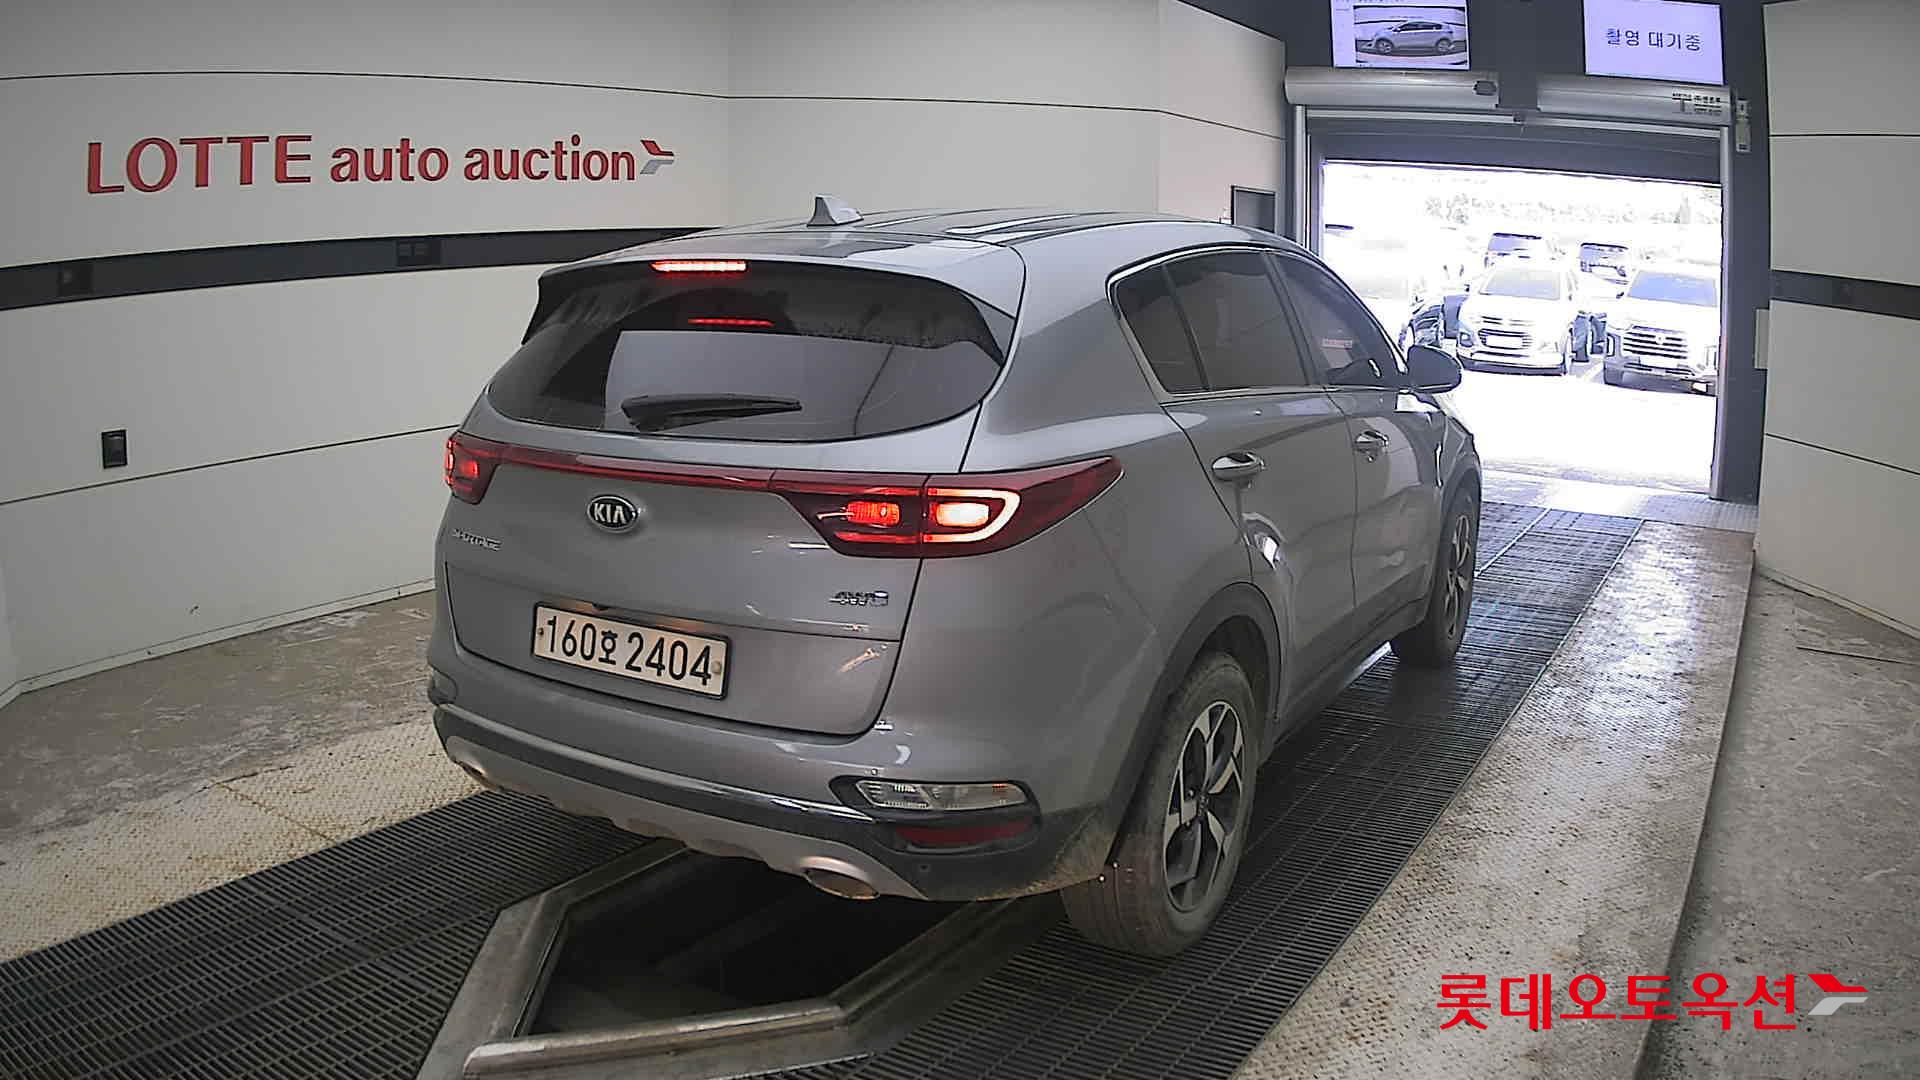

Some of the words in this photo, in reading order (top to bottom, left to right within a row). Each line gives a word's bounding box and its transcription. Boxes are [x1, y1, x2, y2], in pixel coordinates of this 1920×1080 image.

[1648, 31, 1701, 51] 대기중
[87, 134, 312, 194] LOTTE
[329, 138, 449, 182] auto
[463, 134, 635, 182] auction
[593, 500, 625, 527] KIA
[546, 614, 617, 666] 160호
[624, 631, 713, 687] 2404
